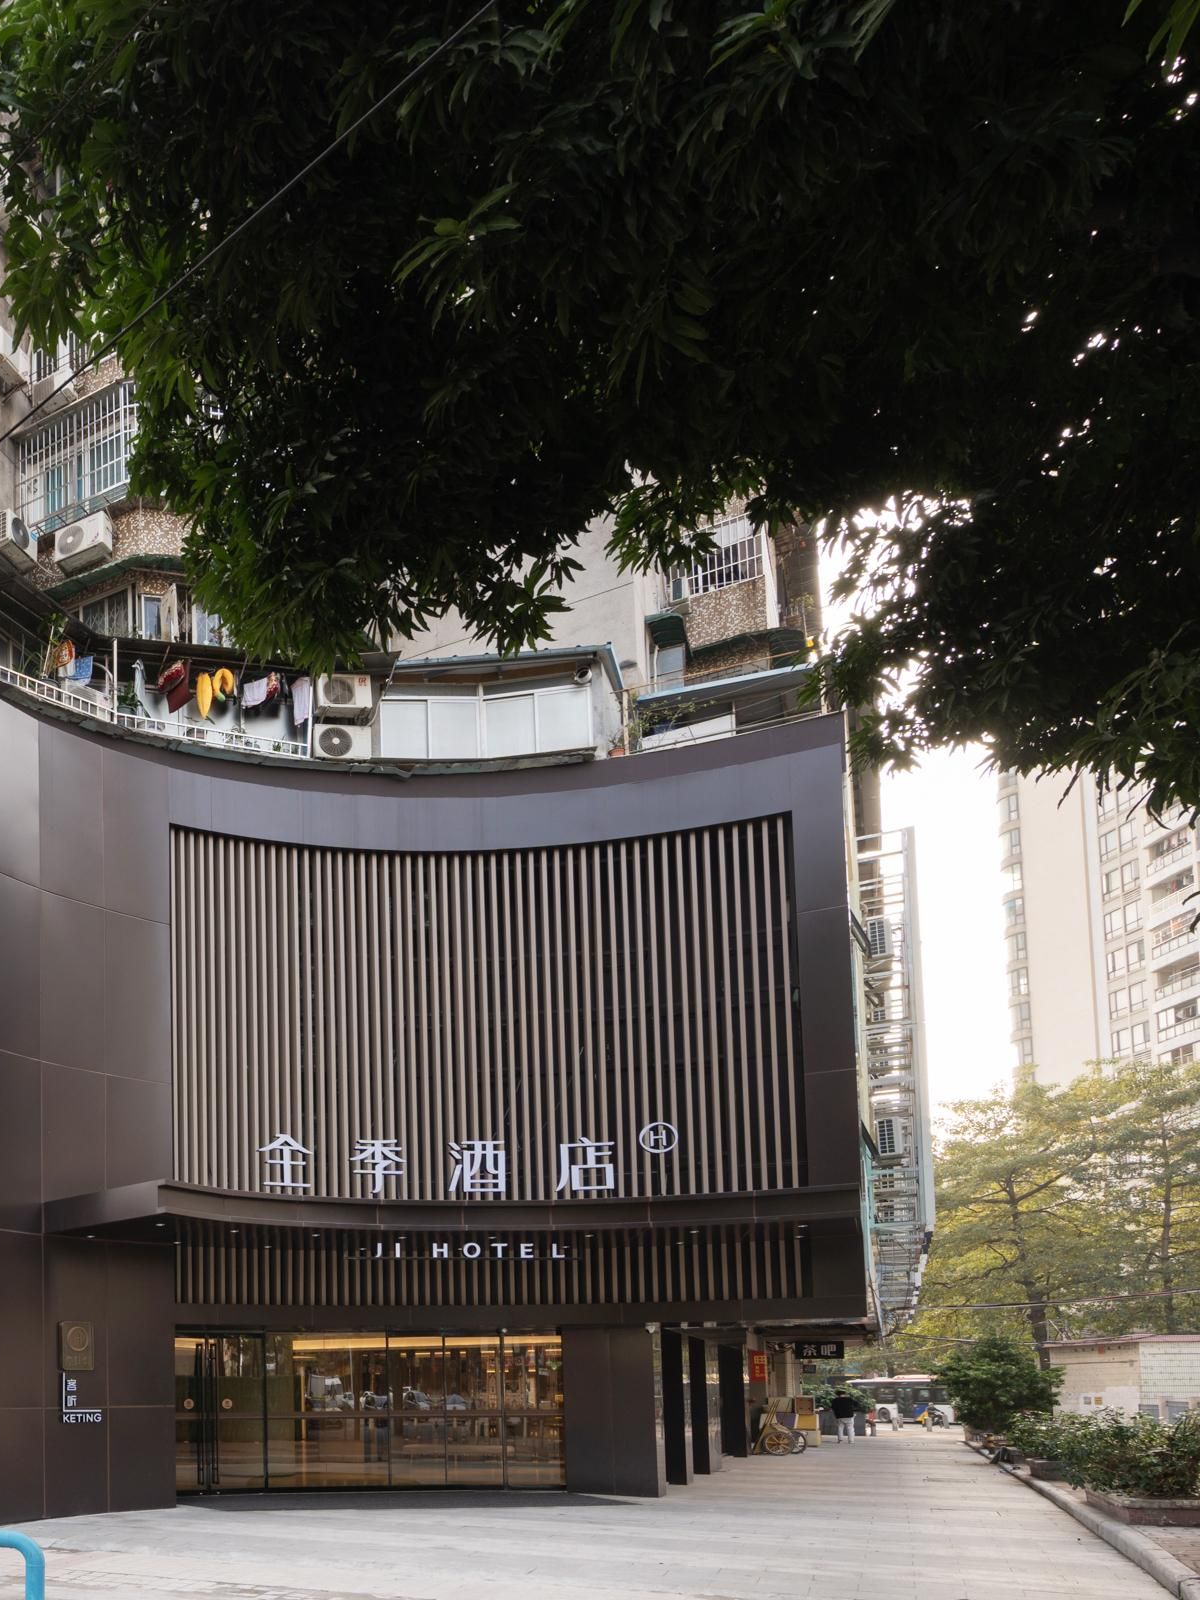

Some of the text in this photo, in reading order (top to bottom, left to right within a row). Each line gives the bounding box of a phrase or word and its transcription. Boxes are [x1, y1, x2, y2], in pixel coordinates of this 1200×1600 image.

[258, 1132, 616, 1194] 全季酒店
[375, 1242, 566, 1259] JI HOTEL
[802, 1343, 838, 1357] 茶吧
[62, 1413, 102, 1423] KETING
